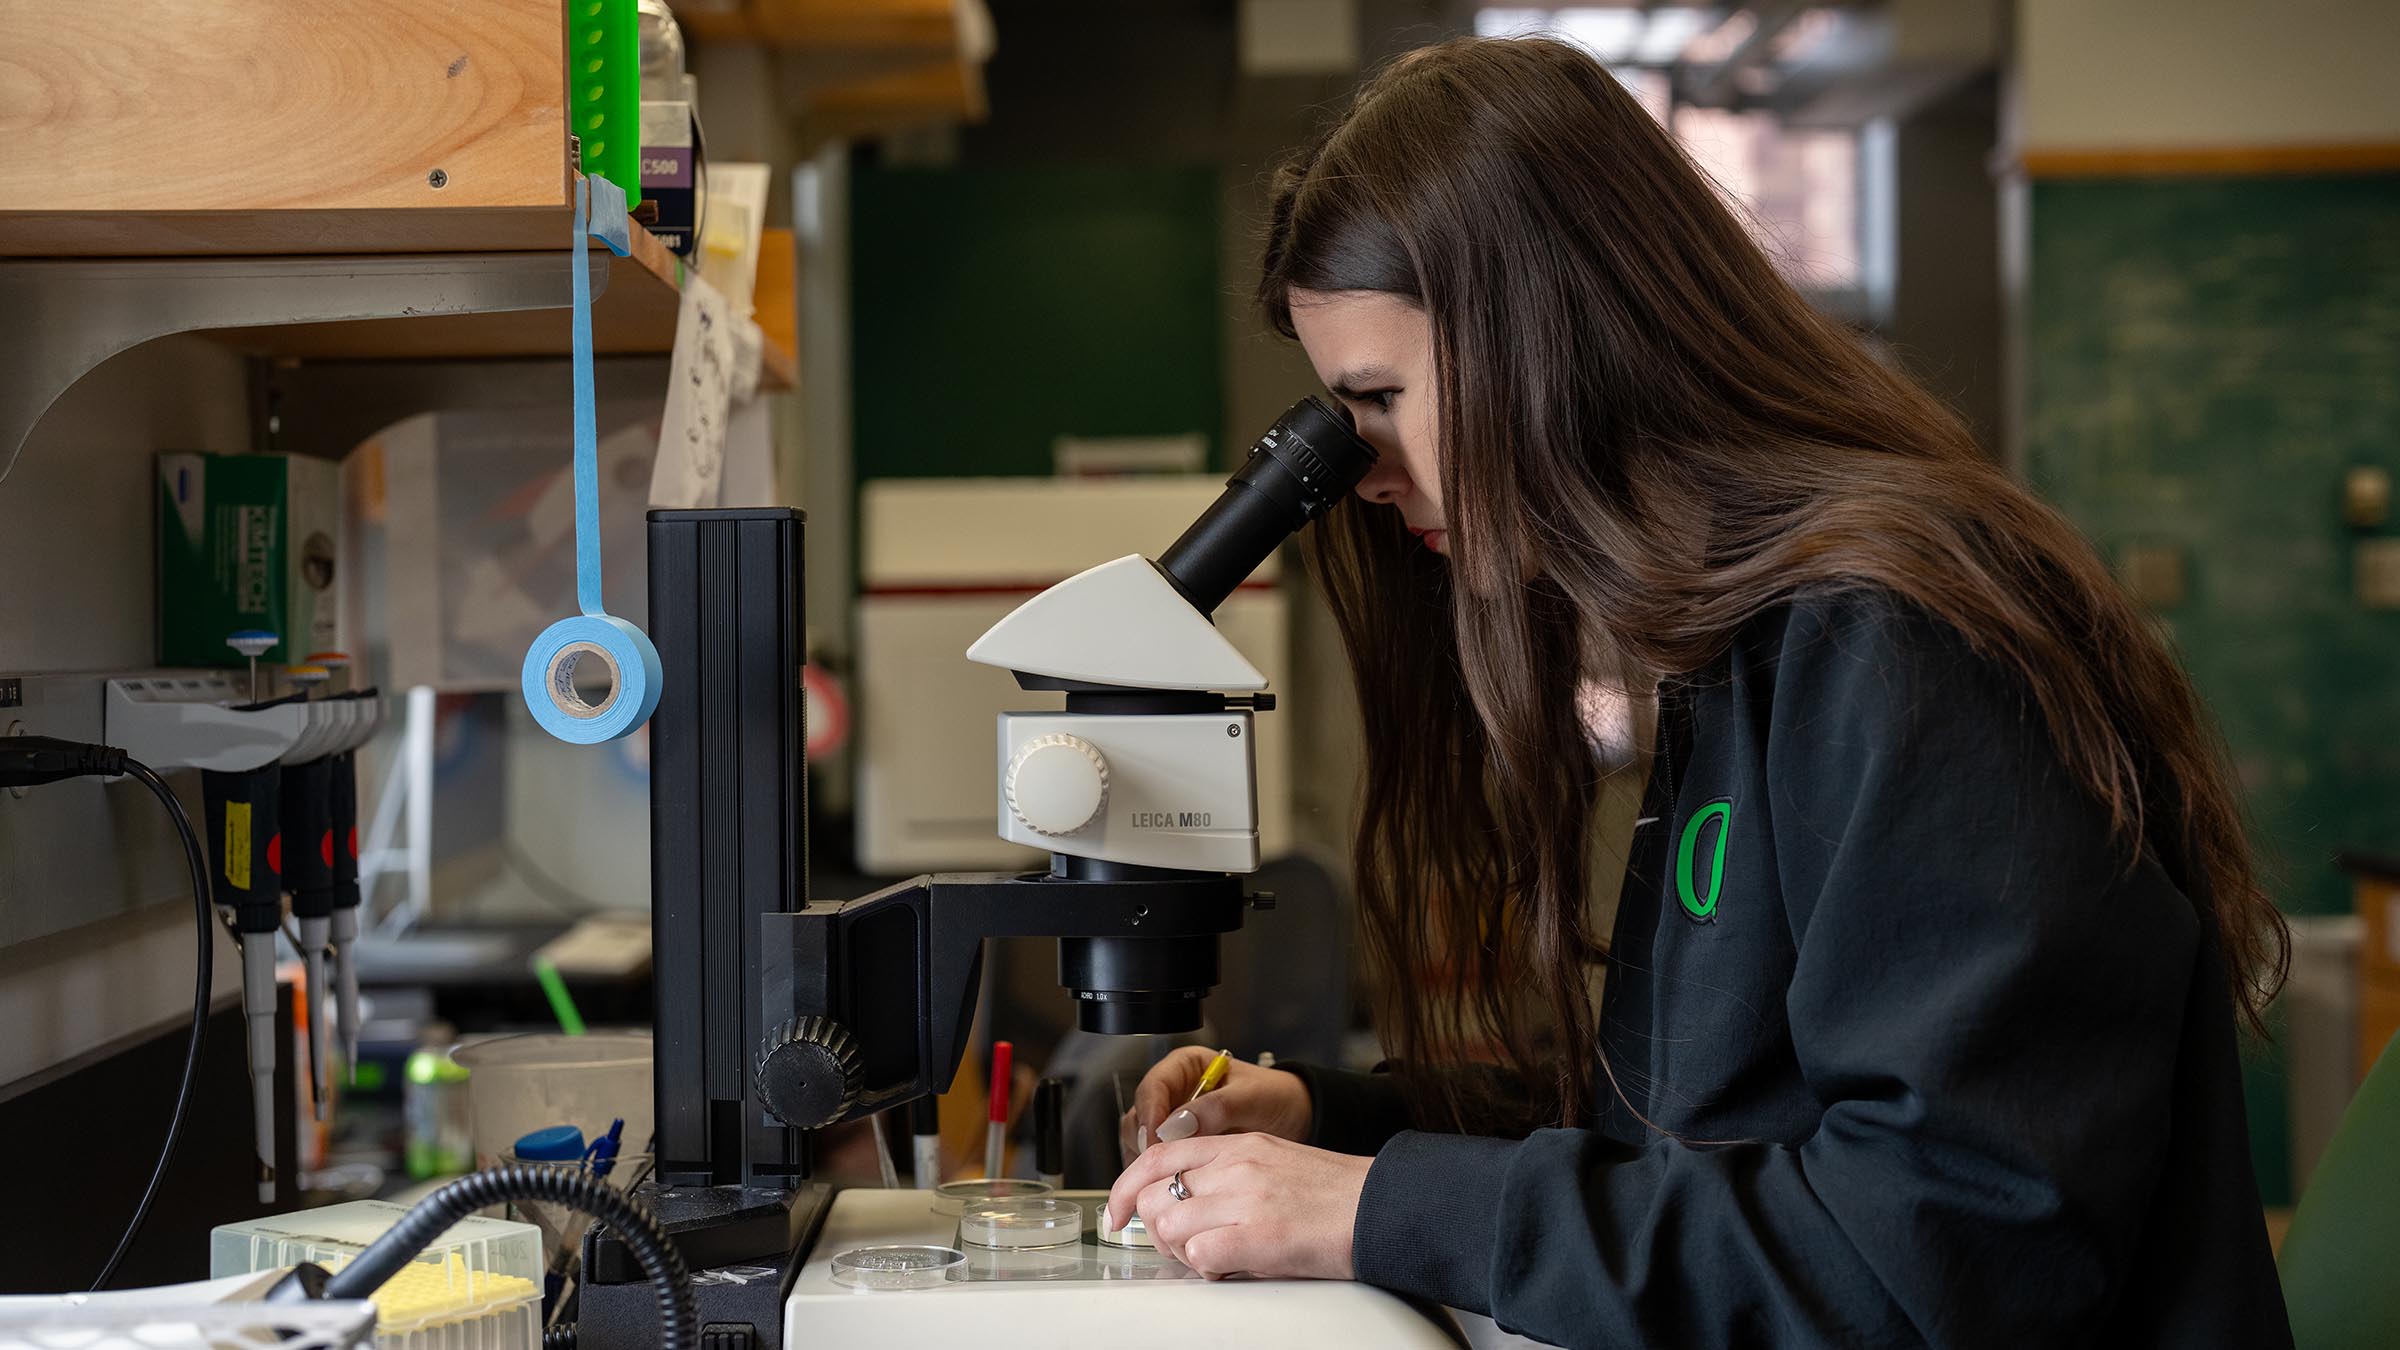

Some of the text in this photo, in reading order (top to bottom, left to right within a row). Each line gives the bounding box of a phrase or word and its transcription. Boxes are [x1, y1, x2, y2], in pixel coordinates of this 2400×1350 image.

[248, 505, 267, 613] KIMTECH
[1131, 812, 1212, 828] LEICA M80
